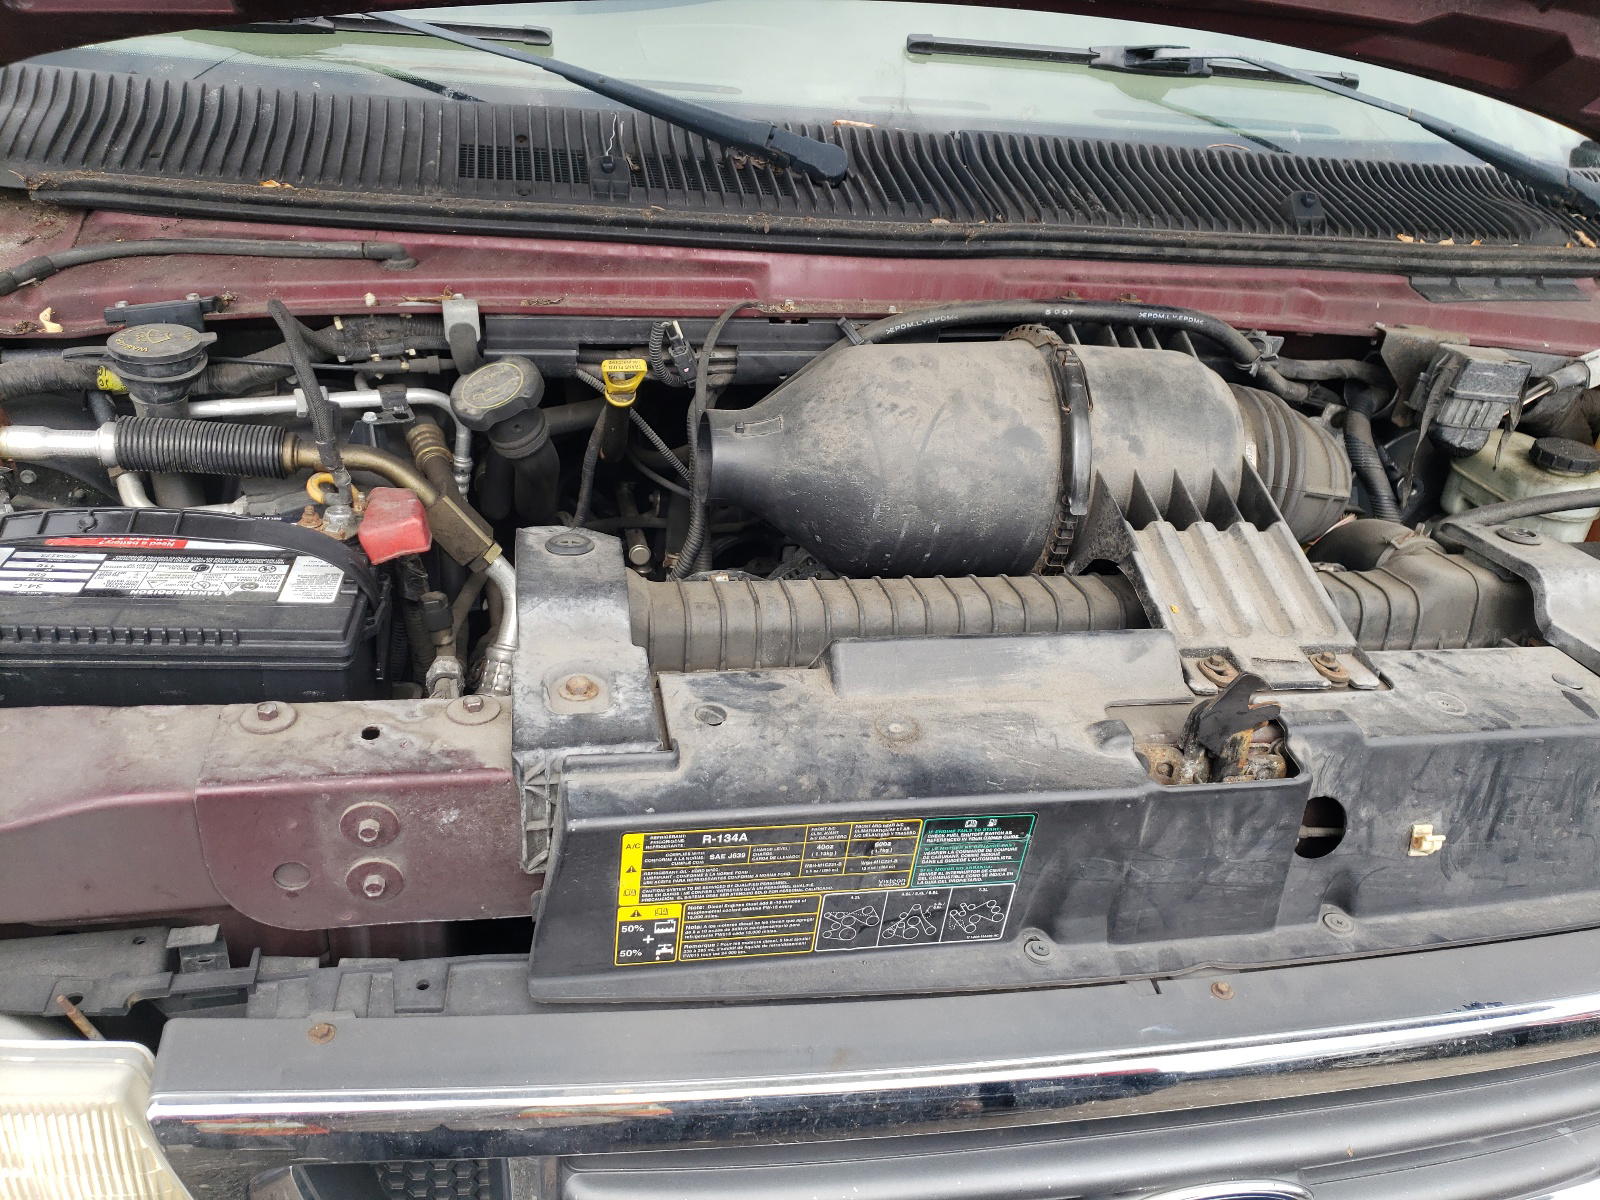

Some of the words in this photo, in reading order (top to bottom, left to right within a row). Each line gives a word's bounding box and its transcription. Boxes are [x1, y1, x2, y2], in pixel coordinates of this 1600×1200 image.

[702, 832, 747, 844] R-134A
[621, 924, 644, 933] 50%
[619, 948, 642, 957] 50%
